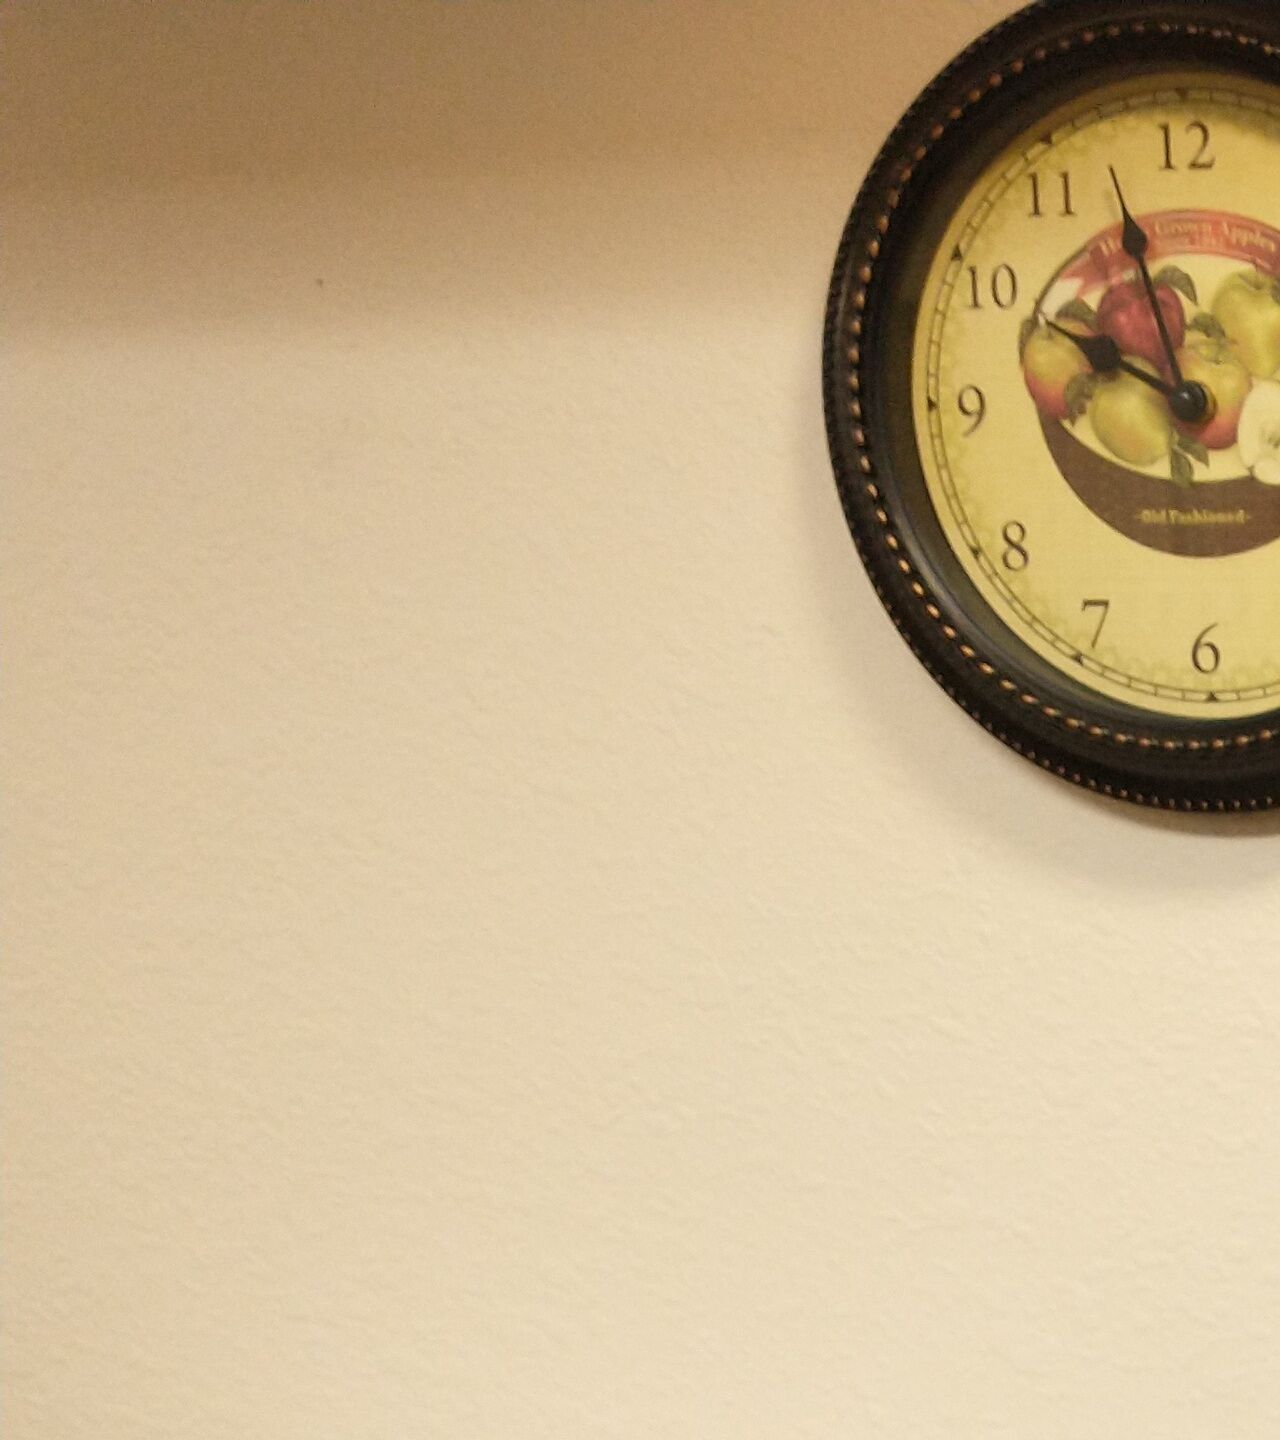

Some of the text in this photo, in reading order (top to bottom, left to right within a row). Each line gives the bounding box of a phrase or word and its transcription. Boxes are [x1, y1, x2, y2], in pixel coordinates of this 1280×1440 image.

[1156, 119, 1217, 171] 12
[1025, 171, 1076, 217] 11
[965, 263, 1018, 310] 10
[957, 384, 988, 436] 9
[1000, 520, 1029, 572] 8
[1080, 598, 1111, 650] 7
[1191, 622, 1221, 676] 6
